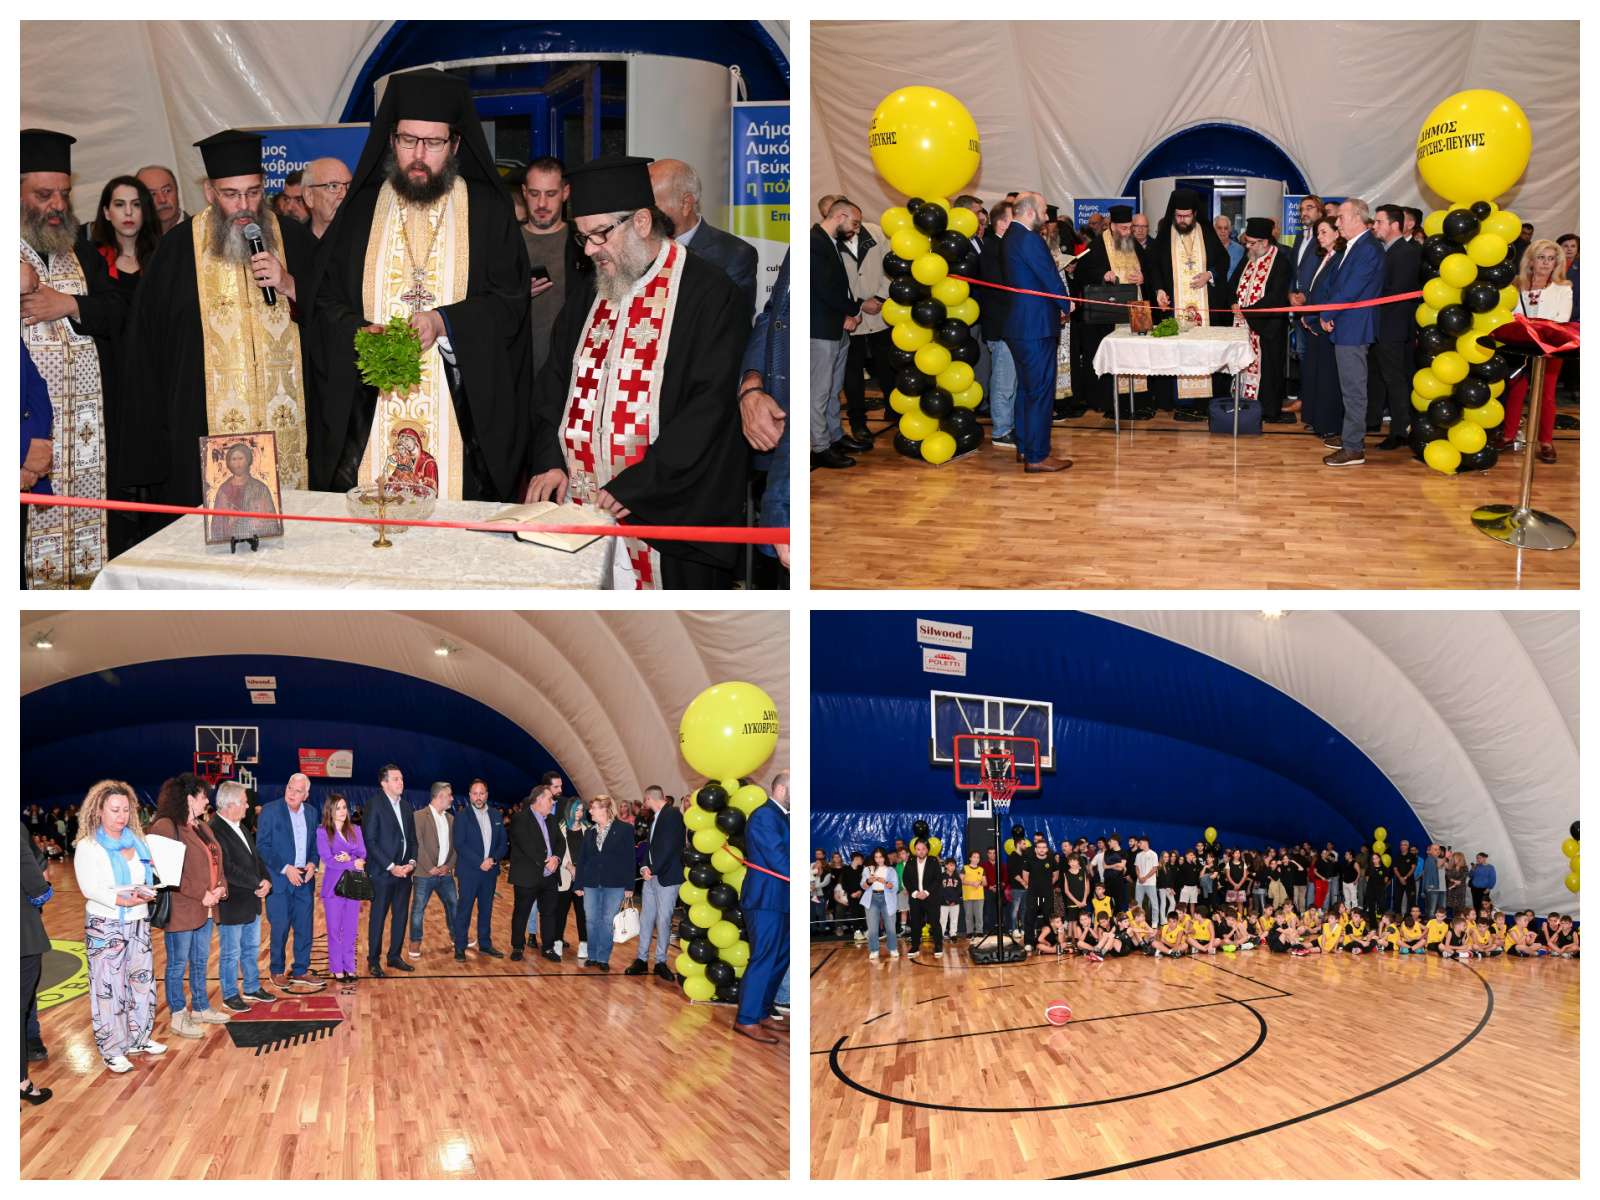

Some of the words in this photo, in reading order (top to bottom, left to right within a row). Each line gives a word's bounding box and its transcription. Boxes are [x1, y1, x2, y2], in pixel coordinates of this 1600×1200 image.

[745, 139, 790, 155] Λυκό
[747, 159, 790, 175] Πεύκ
[746, 182, 757, 197] η
[920, 624, 962, 640] Silwood
